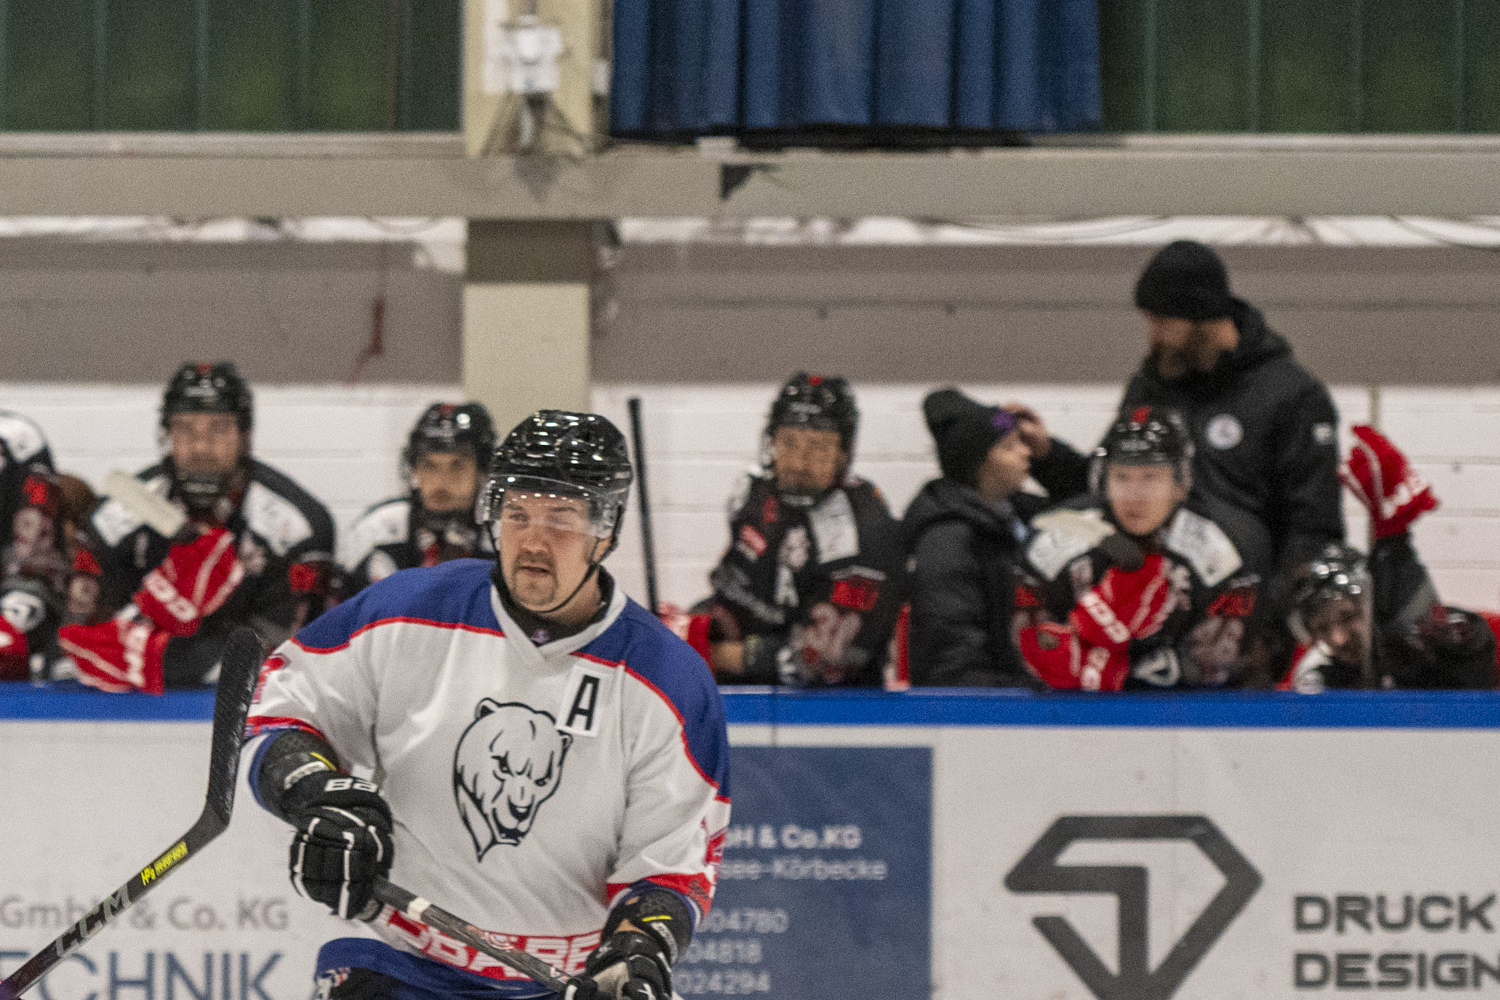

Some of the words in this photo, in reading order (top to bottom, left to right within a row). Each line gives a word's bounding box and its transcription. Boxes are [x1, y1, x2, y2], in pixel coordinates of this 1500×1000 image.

[565, 674, 601, 731] A
[237, 897, 290, 931] KG
[1293, 893, 1496, 934] DRUCK
